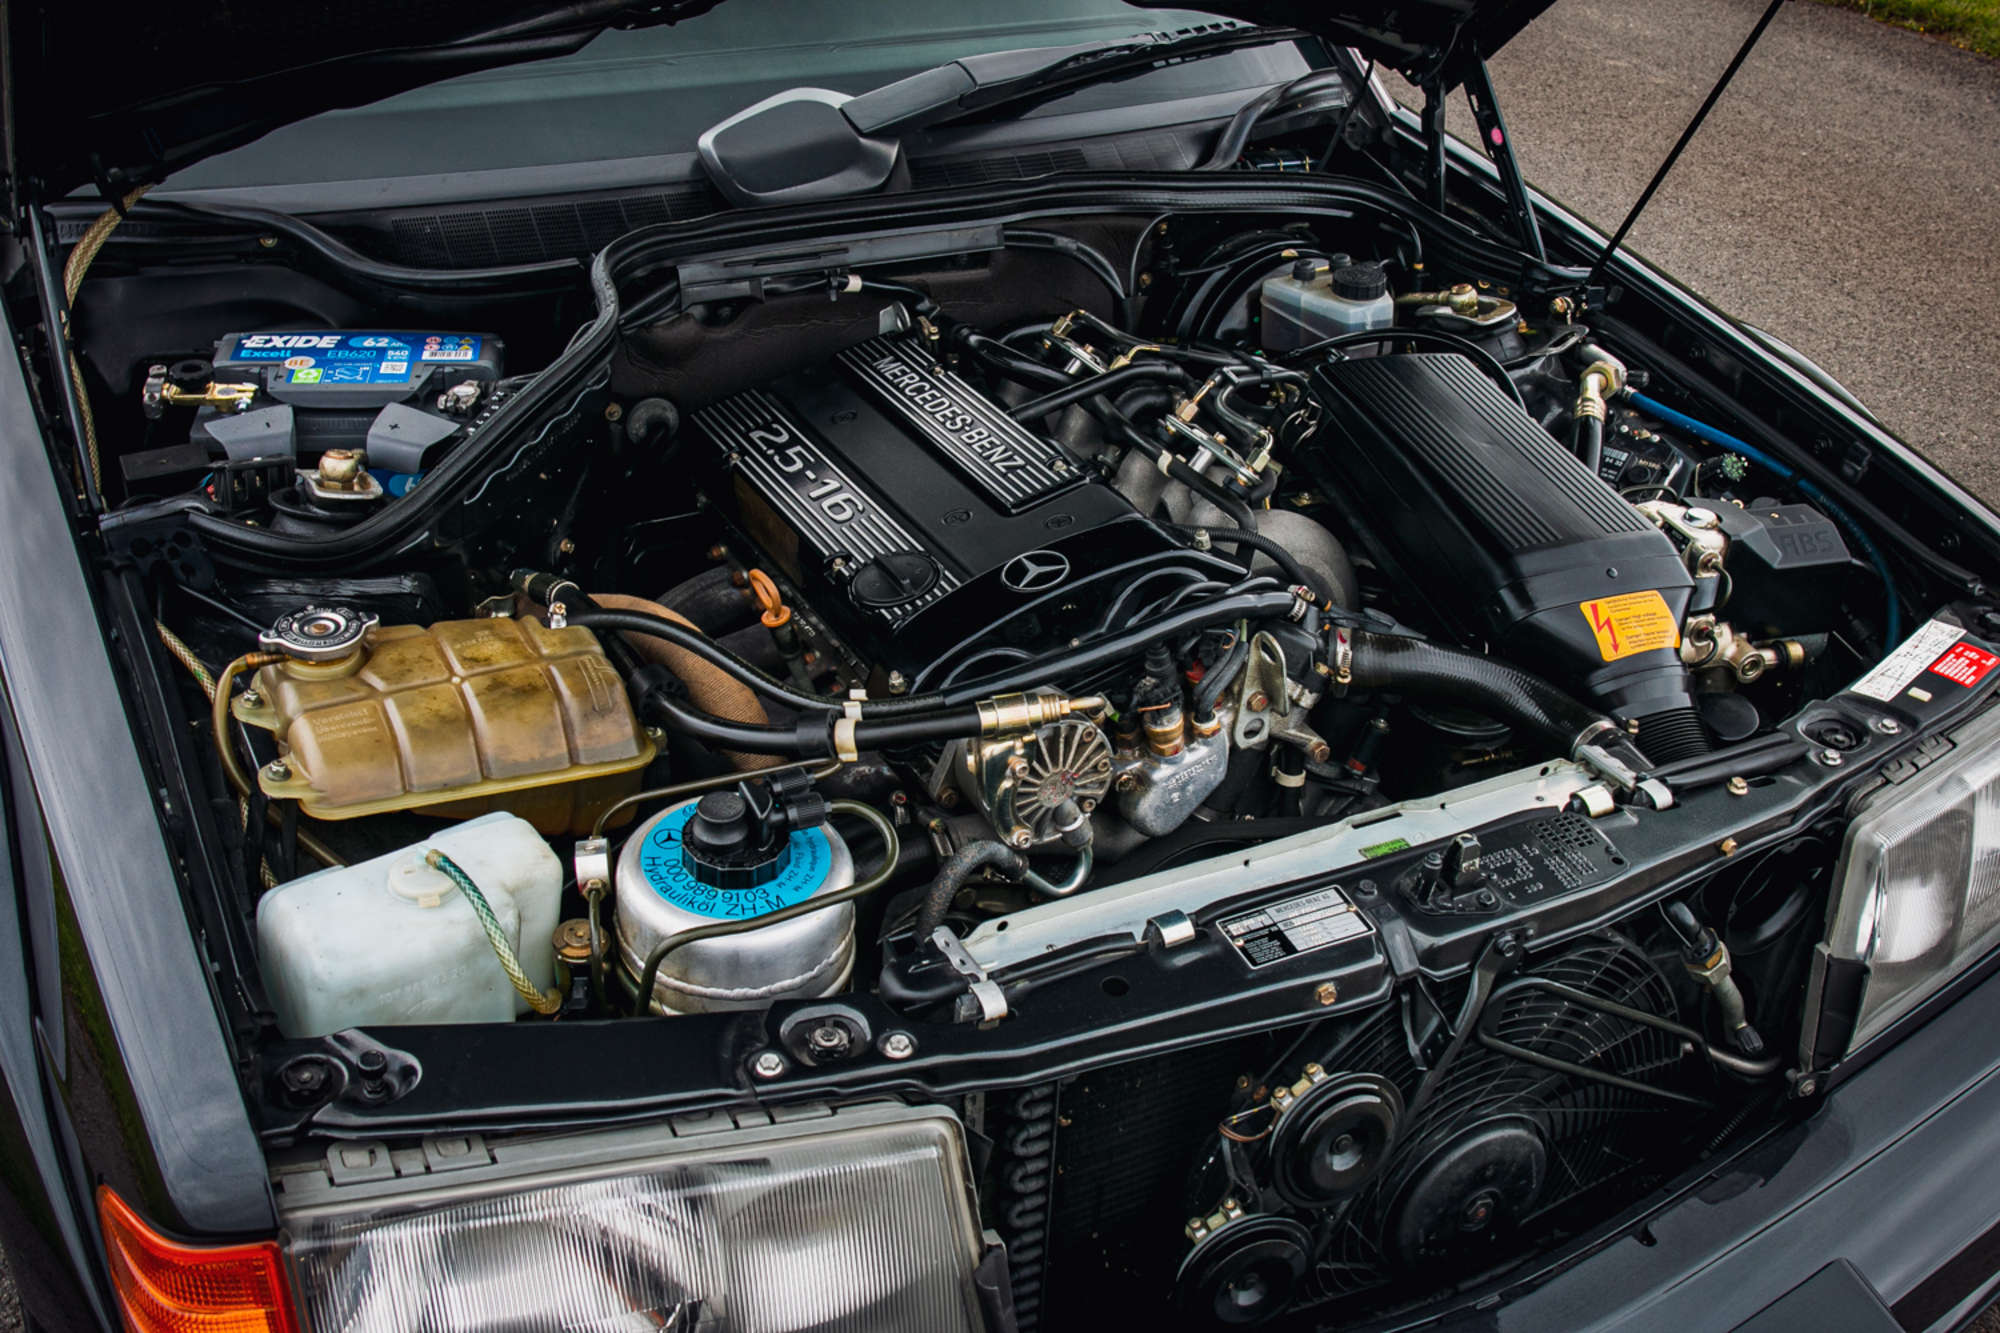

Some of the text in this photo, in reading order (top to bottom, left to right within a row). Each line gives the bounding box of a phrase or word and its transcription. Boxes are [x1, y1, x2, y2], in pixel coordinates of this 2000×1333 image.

[240, 349, 292, 358] Excell
[327, 350, 377, 358] EB620
[241, 335, 342, 348] EXIDE
[362, 337, 390, 347] 62
[872, 354, 1028, 478] MERCEDES-BENZ
[748, 422, 866, 524] 2.5-16
[1780, 530, 1834, 558] ABS
[644, 856, 717, 914] Hydrauliköl
[725, 894, 787, 916] ZH-M
[663, 858, 689, 883] 000
[683, 880, 718, 901] 989
